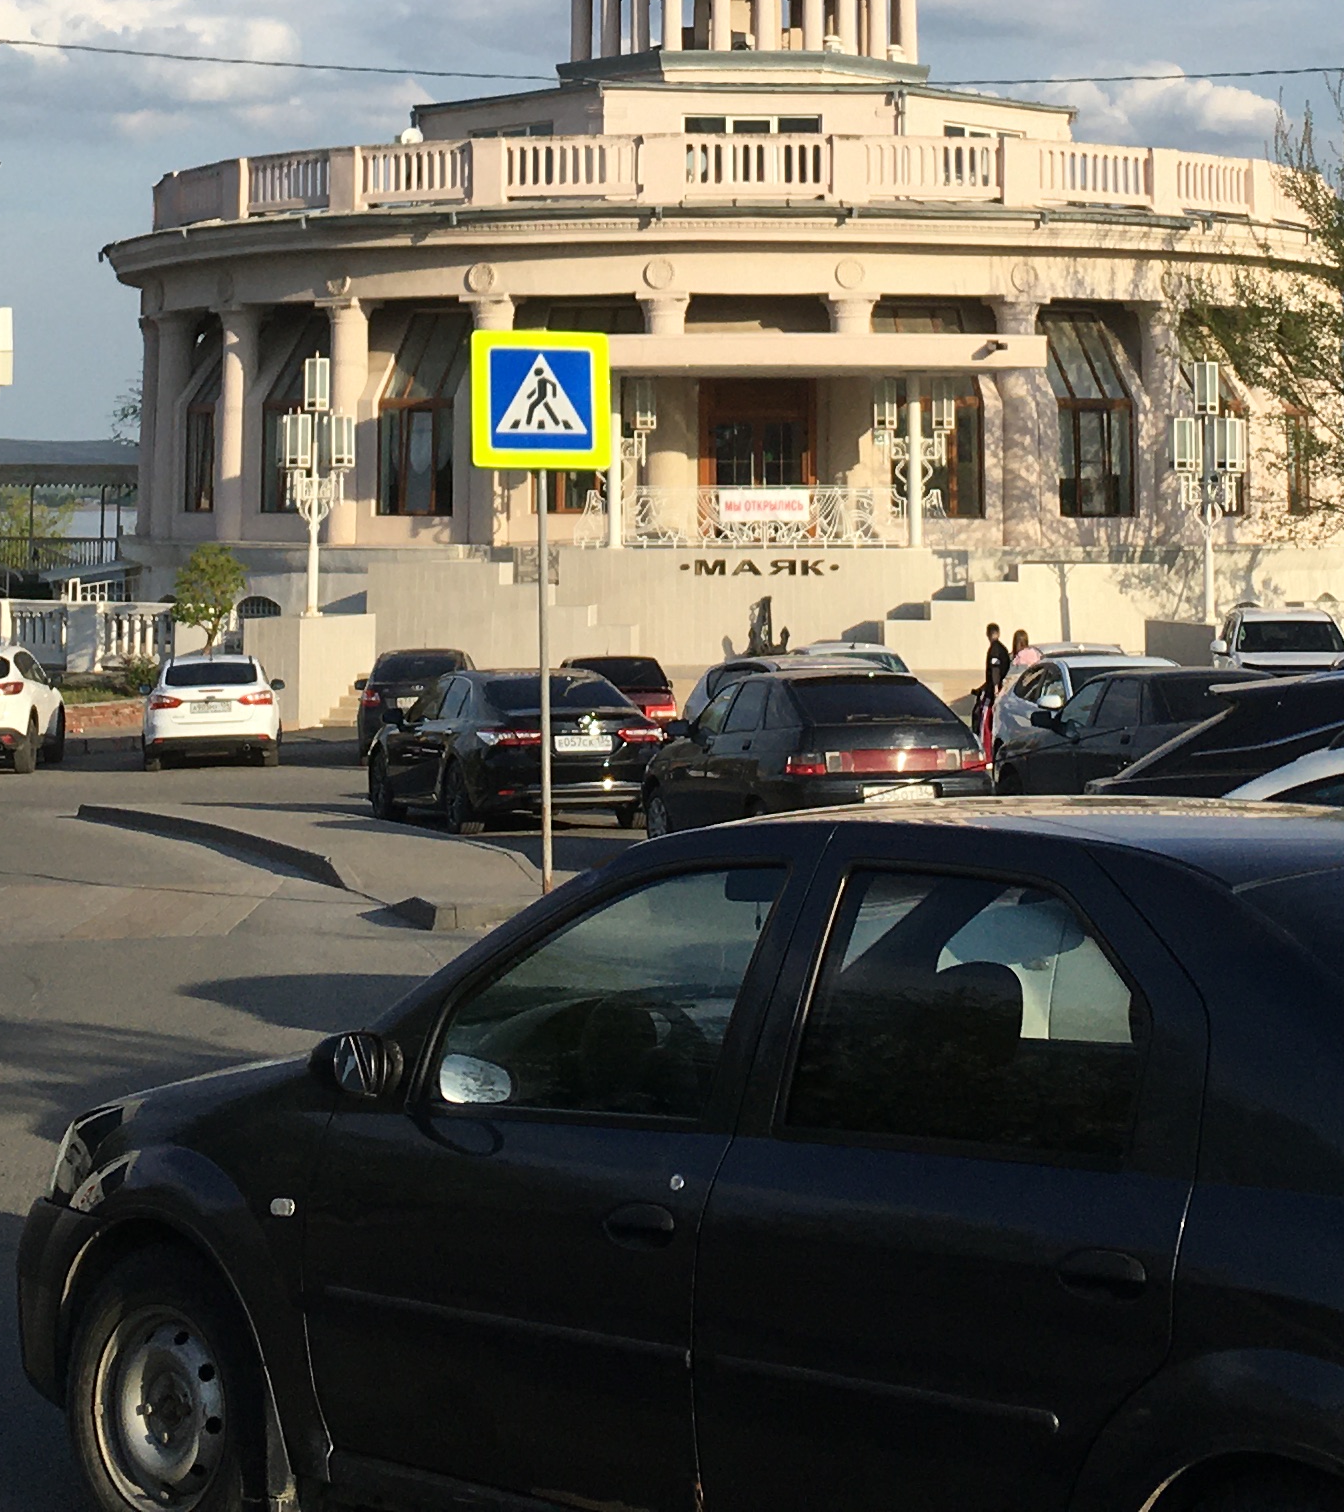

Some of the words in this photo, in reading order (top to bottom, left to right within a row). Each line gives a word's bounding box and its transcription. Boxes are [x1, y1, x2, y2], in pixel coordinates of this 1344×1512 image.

[725, 500, 742, 511] МЫ
[744, 500, 804, 512] ОТКРЫЛИСЬ
[694, 559, 825, 576] МАЯК
